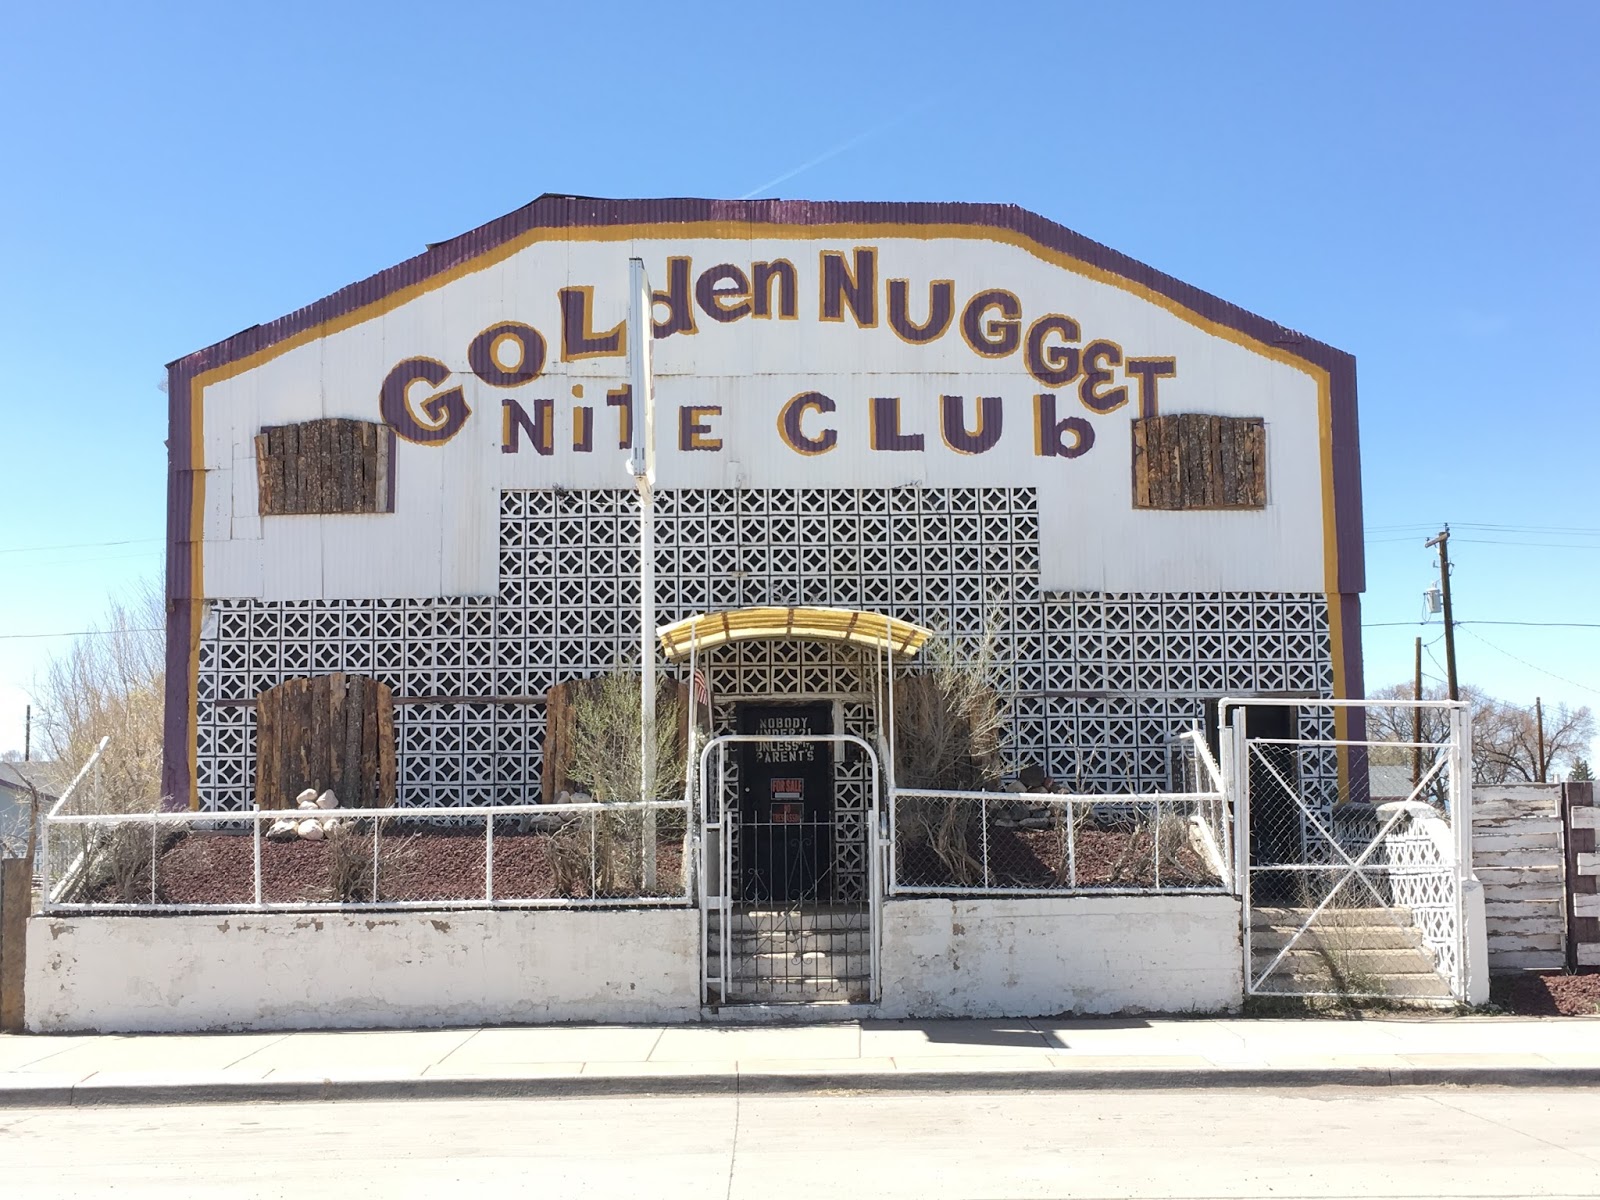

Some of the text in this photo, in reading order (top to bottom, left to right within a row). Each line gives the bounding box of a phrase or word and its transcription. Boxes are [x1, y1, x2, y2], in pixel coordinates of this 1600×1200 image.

[819, 246, 1177, 418] NUGGET
[759, 717, 808, 729] NOBODY
[755, 741, 799, 752] UNLESS
[755, 749, 815, 763] PARENT'S
[773, 780, 802, 792] FOR SALE
